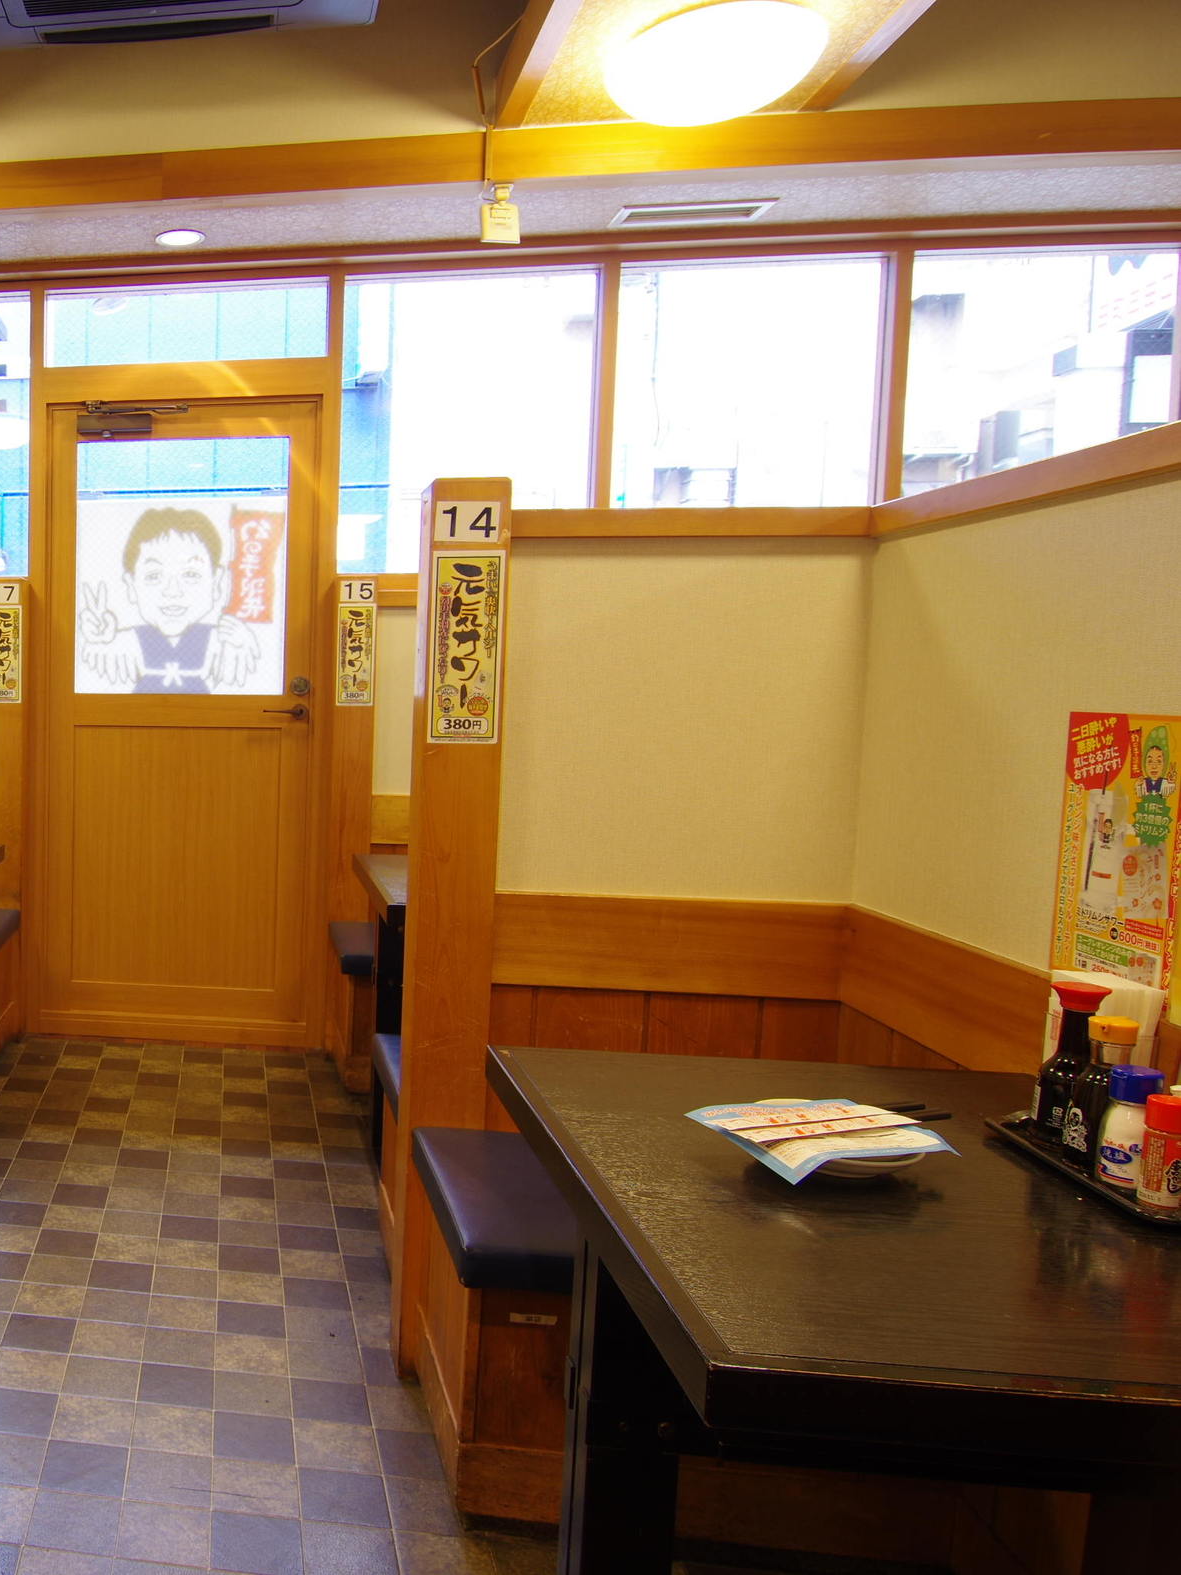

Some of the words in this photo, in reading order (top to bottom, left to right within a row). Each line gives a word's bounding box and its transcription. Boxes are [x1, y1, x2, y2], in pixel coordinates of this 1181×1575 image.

[443, 506, 497, 538] 14
[344, 582, 374, 600] 15
[443, 718, 482, 730] 380円
